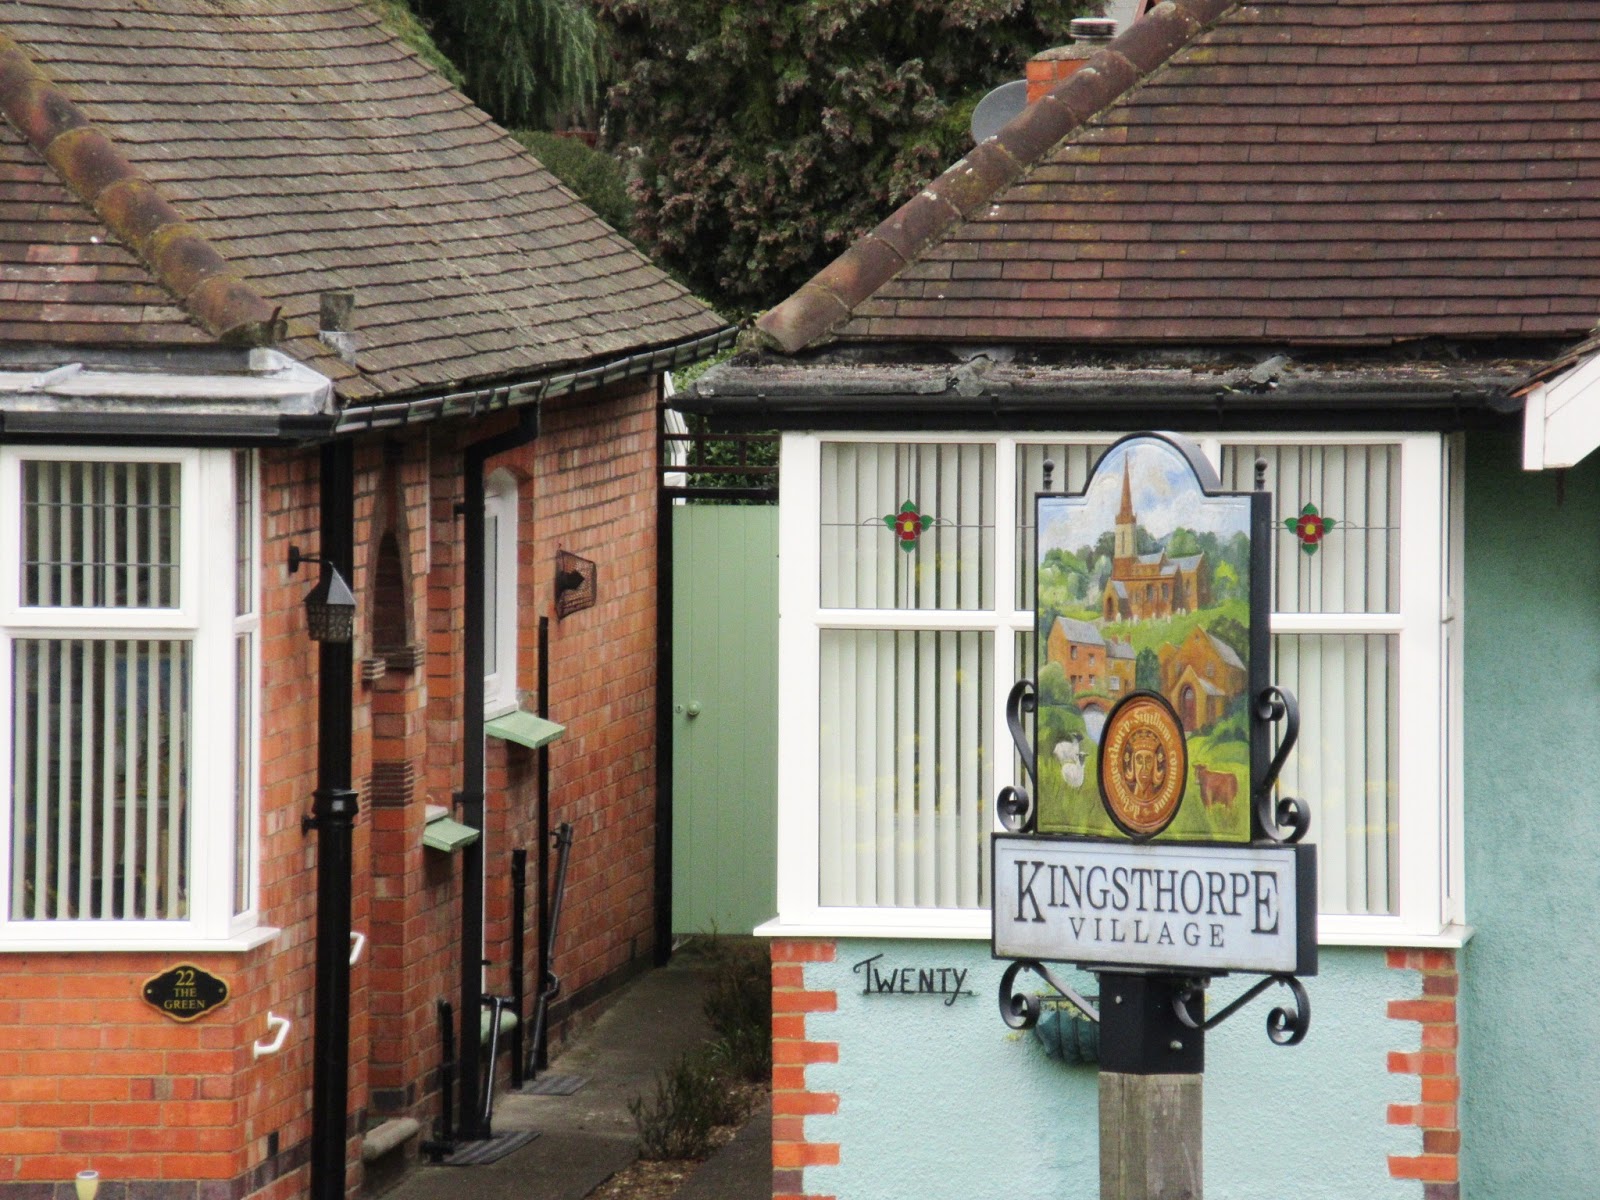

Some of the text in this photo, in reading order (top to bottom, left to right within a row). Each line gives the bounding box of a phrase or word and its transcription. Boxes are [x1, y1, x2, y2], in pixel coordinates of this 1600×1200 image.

[1013, 860, 1279, 935] KINGSTHORPE
[1068, 917, 1225, 948] VILLAGE
[175, 970, 195, 986] 22
[174, 988, 197, 998] THE
[164, 1000, 206, 1010] GREEN
